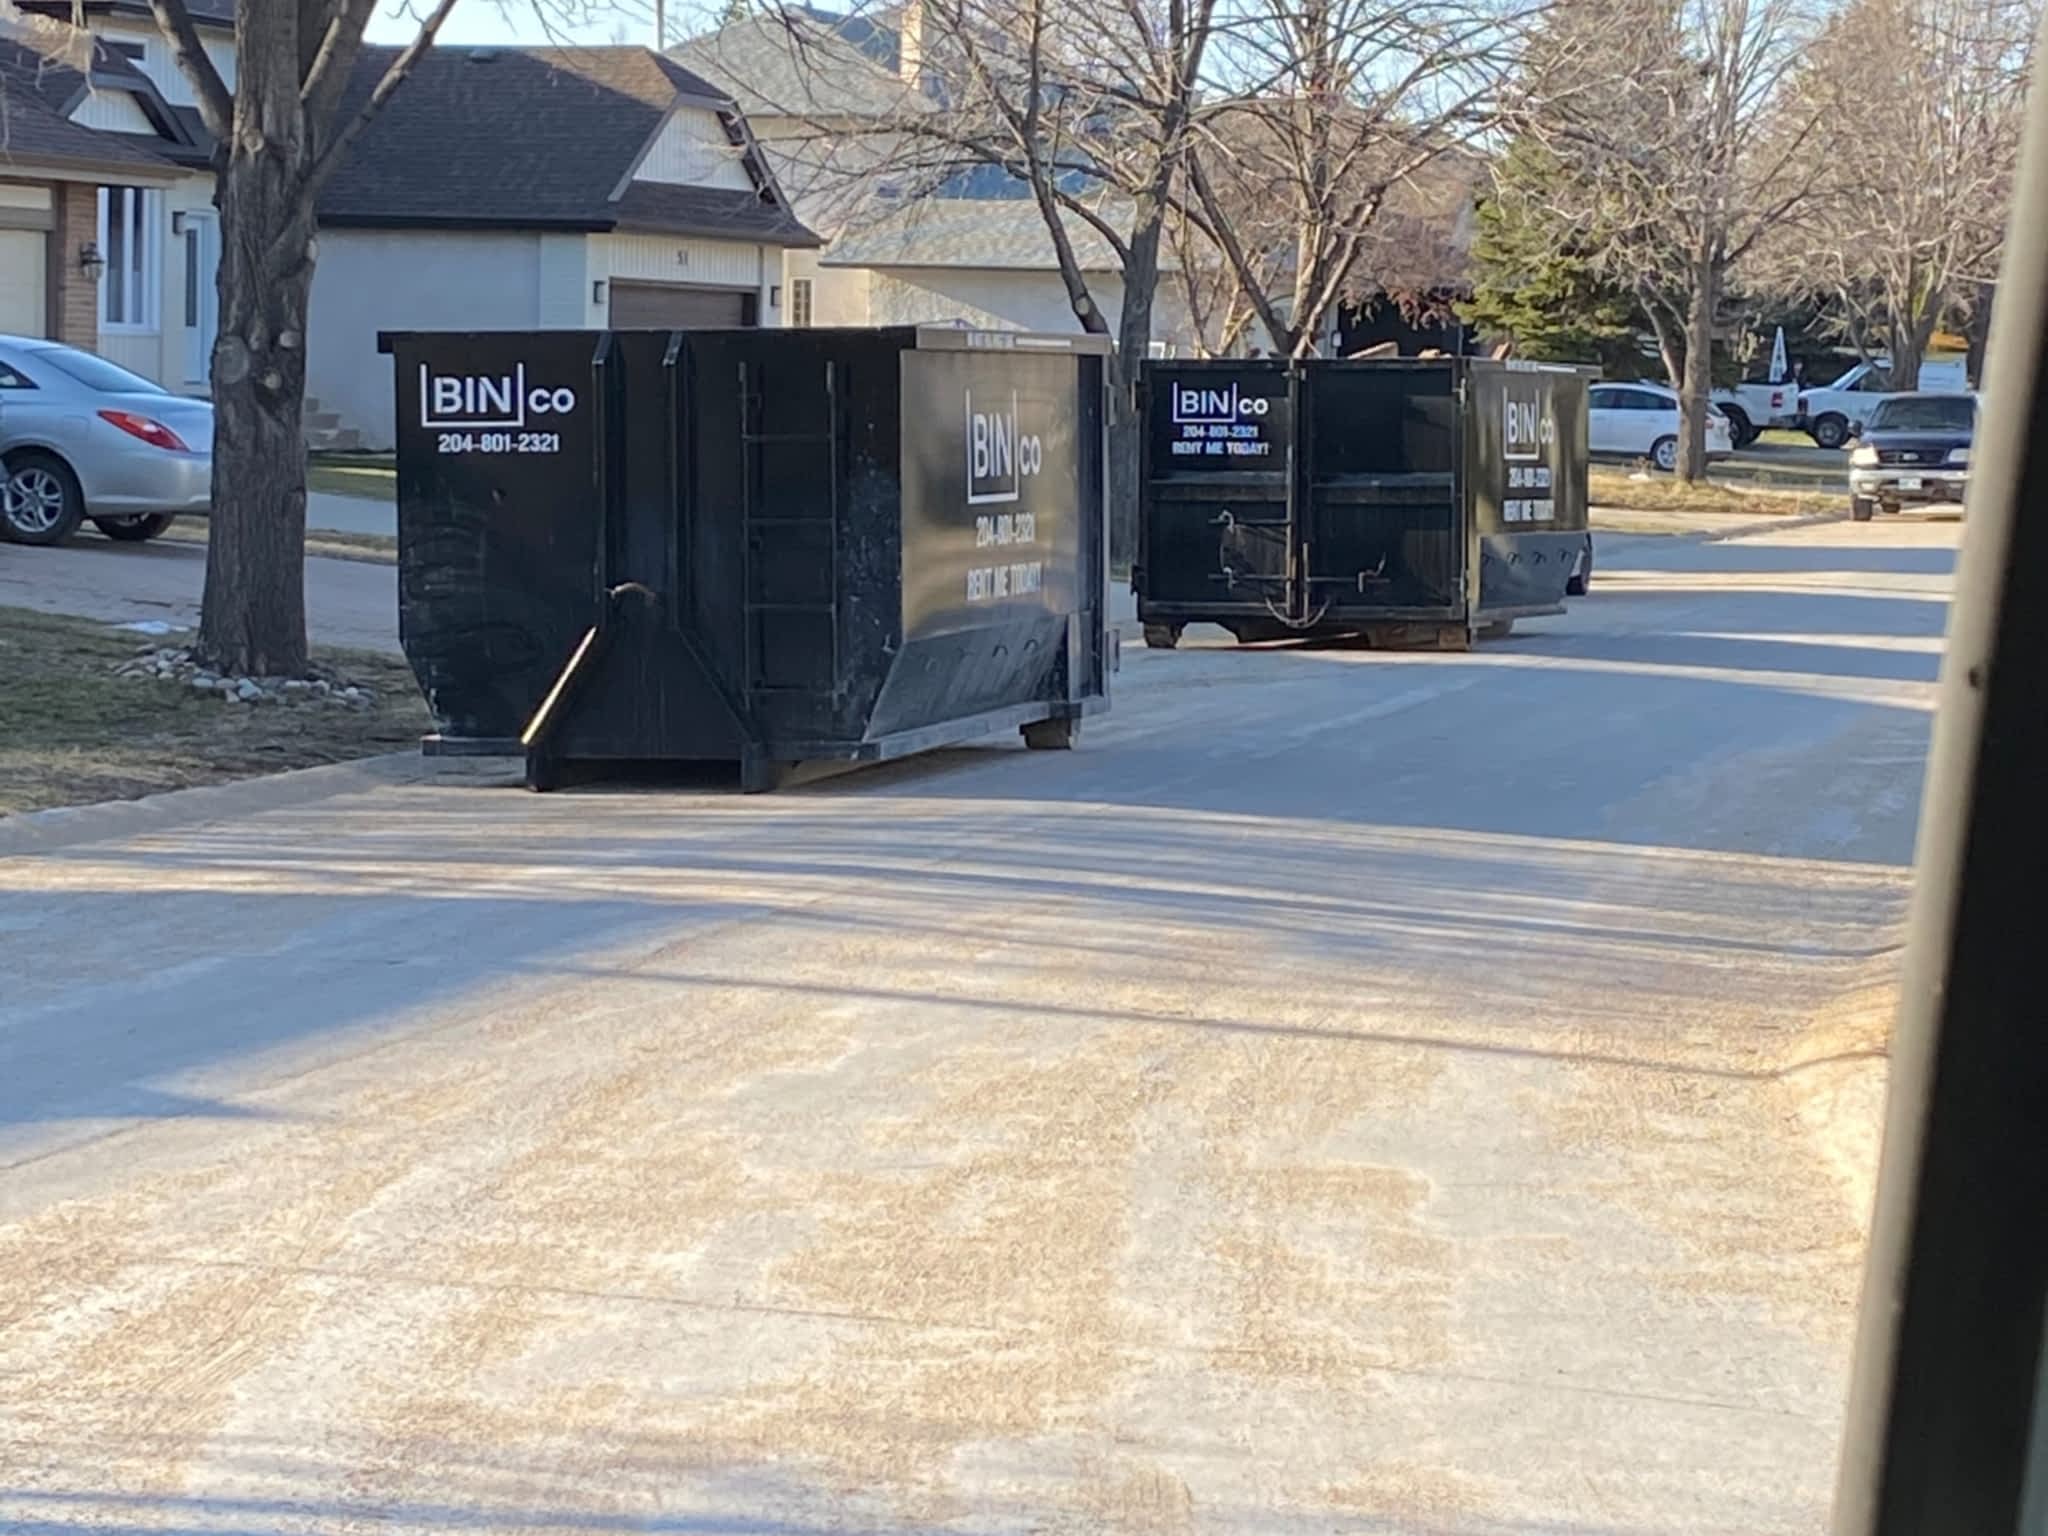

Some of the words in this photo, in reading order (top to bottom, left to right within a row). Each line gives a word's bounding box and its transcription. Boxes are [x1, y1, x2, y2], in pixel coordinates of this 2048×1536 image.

[433, 376, 512, 414] BIN
[528, 387, 576, 414] co
[1180, 389, 1230, 415] BIN
[1507, 401, 1535, 444] BIN
[437, 432, 560, 453] 204-801-2321
[972, 412, 1012, 478] BIN
[1172, 441, 1202, 455] RENT
[1205, 441, 1224, 455] ME
